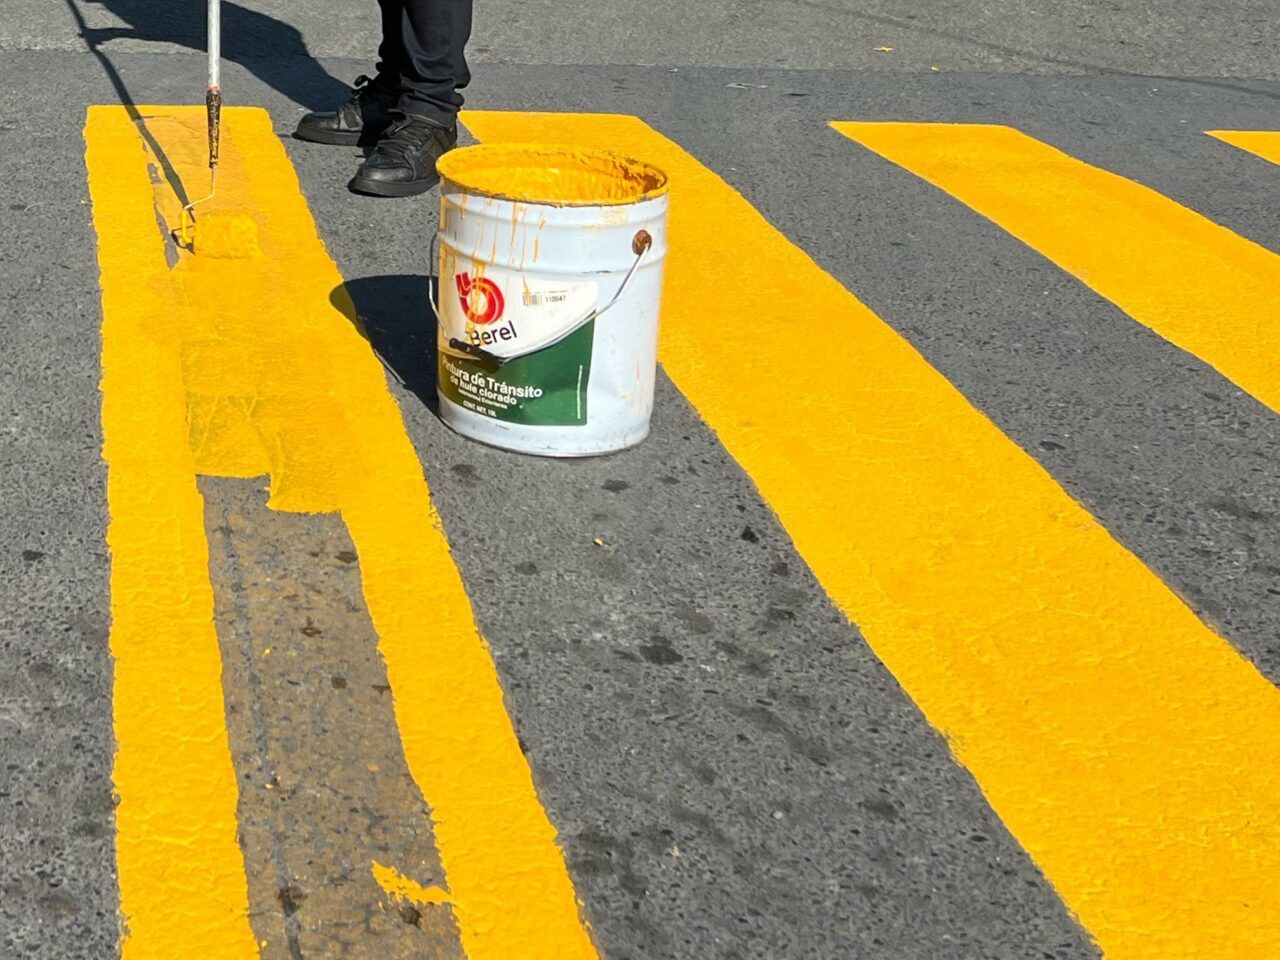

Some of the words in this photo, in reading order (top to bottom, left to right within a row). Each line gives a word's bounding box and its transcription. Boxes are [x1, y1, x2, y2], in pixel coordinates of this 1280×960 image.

[460, 379, 477, 393] hule
[479, 387, 517, 405] clorado
[471, 372, 485, 387] de
[486, 377, 543, 398] Tránsito
